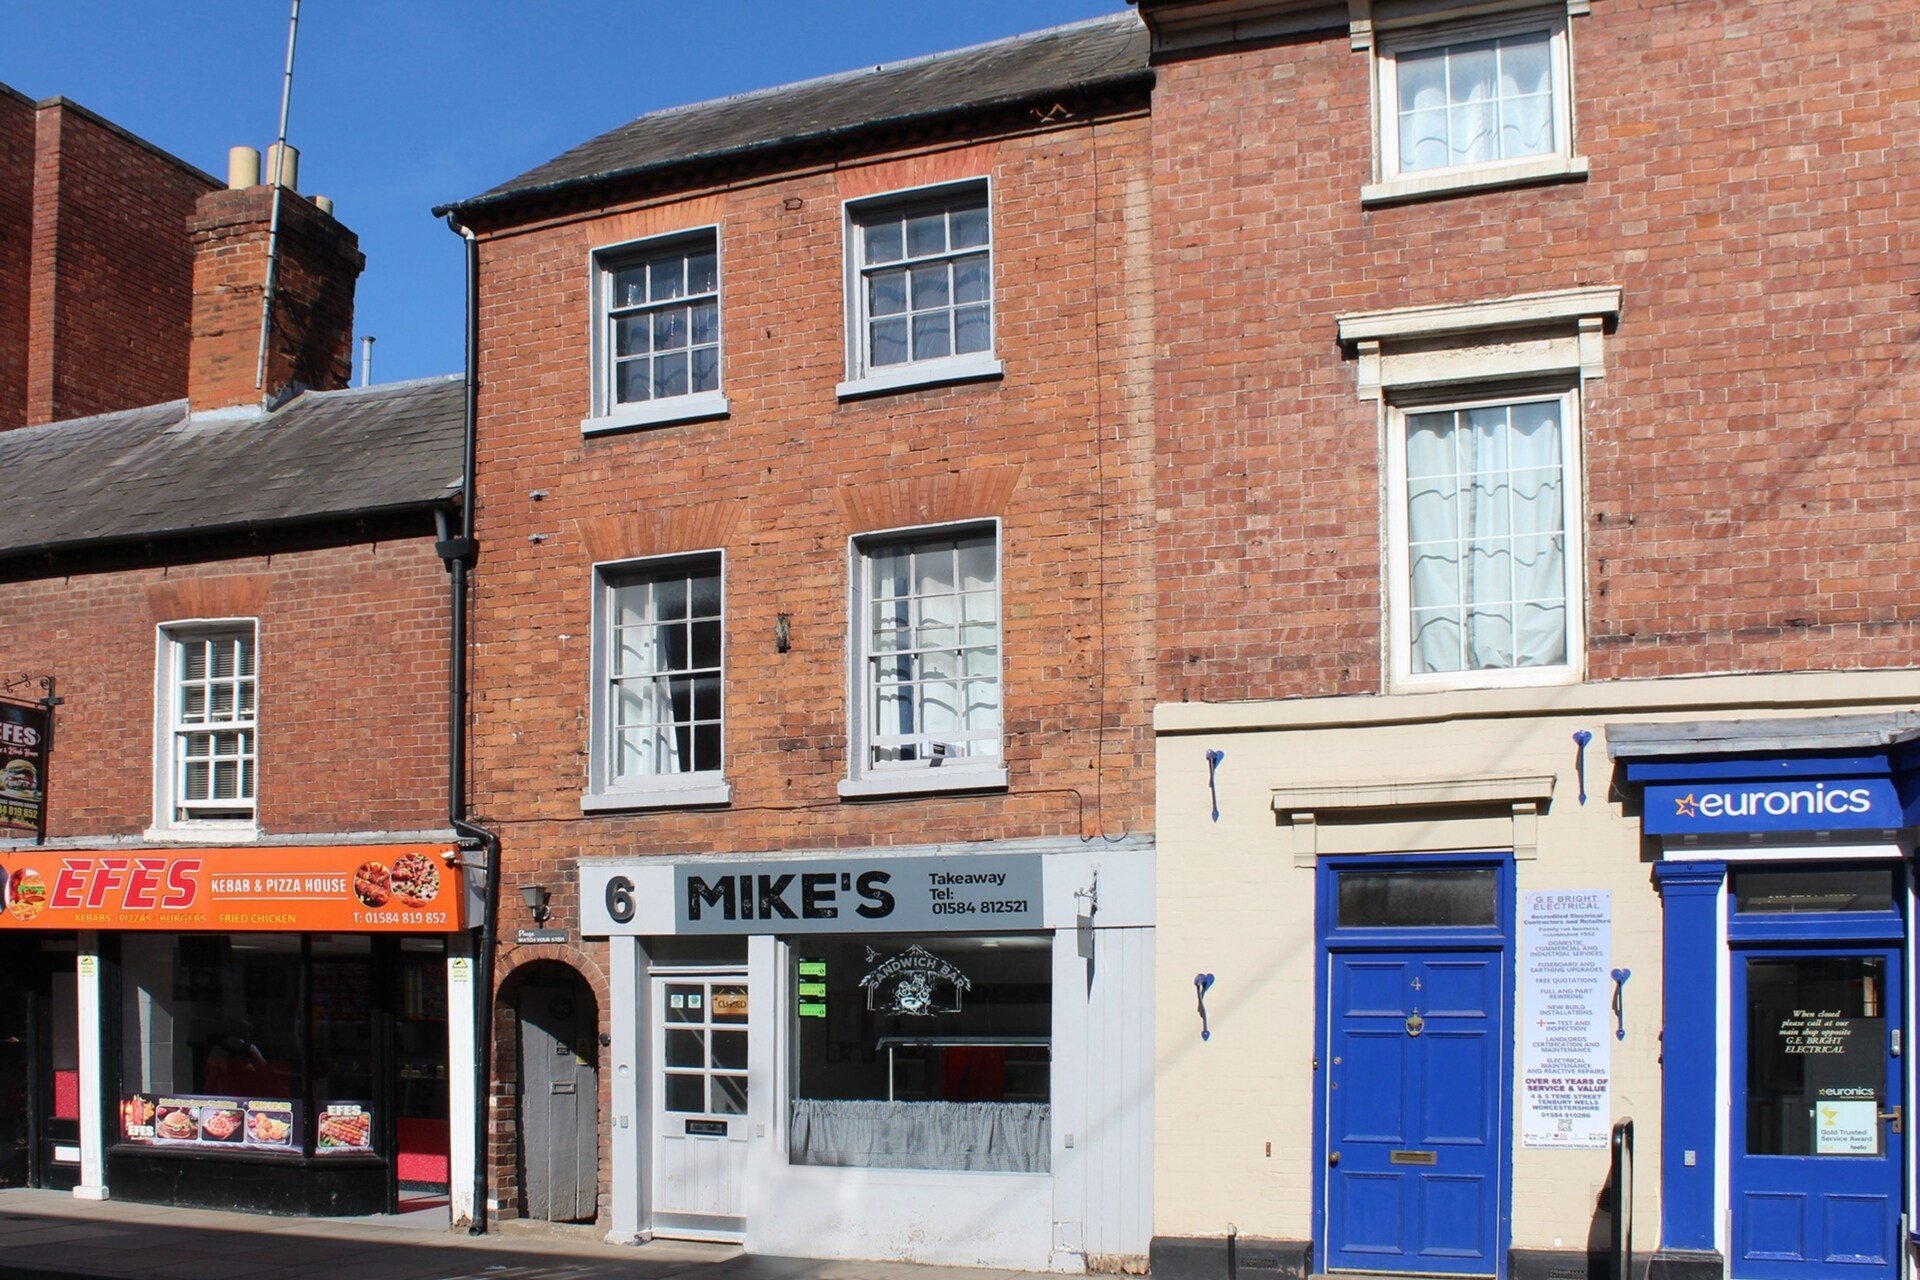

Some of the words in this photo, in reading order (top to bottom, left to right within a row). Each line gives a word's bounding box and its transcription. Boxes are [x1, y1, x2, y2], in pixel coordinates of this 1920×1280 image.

[0, 722, 37, 746] FES
[1699, 782, 1871, 817] euronics
[8, 806, 22, 816] 819
[23, 808, 38, 819] 852
[49, 858, 203, 910] EFES
[929, 872, 1006, 886] Takeaway
[211, 878, 250, 893] KEBAB
[254, 879, 262, 892] &
[266, 878, 301, 892] PIZZA
[305, 878, 347, 893] HOUSE
[605, 875, 637, 924] 6
[687, 870, 896, 921] MIKE'S
[929, 888, 954, 900] Tel:
[1557, 895, 1598, 903] BRIGHT
[932, 902, 976, 915] 01584
[980, 900, 1028, 913] 812521
[74, 914, 111, 923] KEBABS
[119, 914, 152, 923] PIZZAS
[160, 914, 205, 923] BURGERS
[219, 914, 248, 923] FRIED
[251, 914, 296, 924] CHICKEN
[353, 912, 363, 923] T:
[365, 912, 399, 924] 01584
[402, 912, 423, 924] 819
[425, 912, 447, 924] 852
[869, 957, 937, 990] SANDWICH
[940, 964, 965, 990] BAR
[1410, 976, 1422, 991] 4
[1781, 1019, 1805, 1028] please
[1802, 1028, 1819, 1037] shop
[1821, 1028, 1851, 1037] opposite
[1786, 1036, 1803, 1044] G.E.
[1806, 1036, 1844, 1044] BRIGHT
[1784, 1045, 1845, 1053] ELECTRICAL
[1825, 1086, 1874, 1095] euronics
[327, 1104, 362, 1116] EFES
[128, 1125, 154, 1137] EFES
